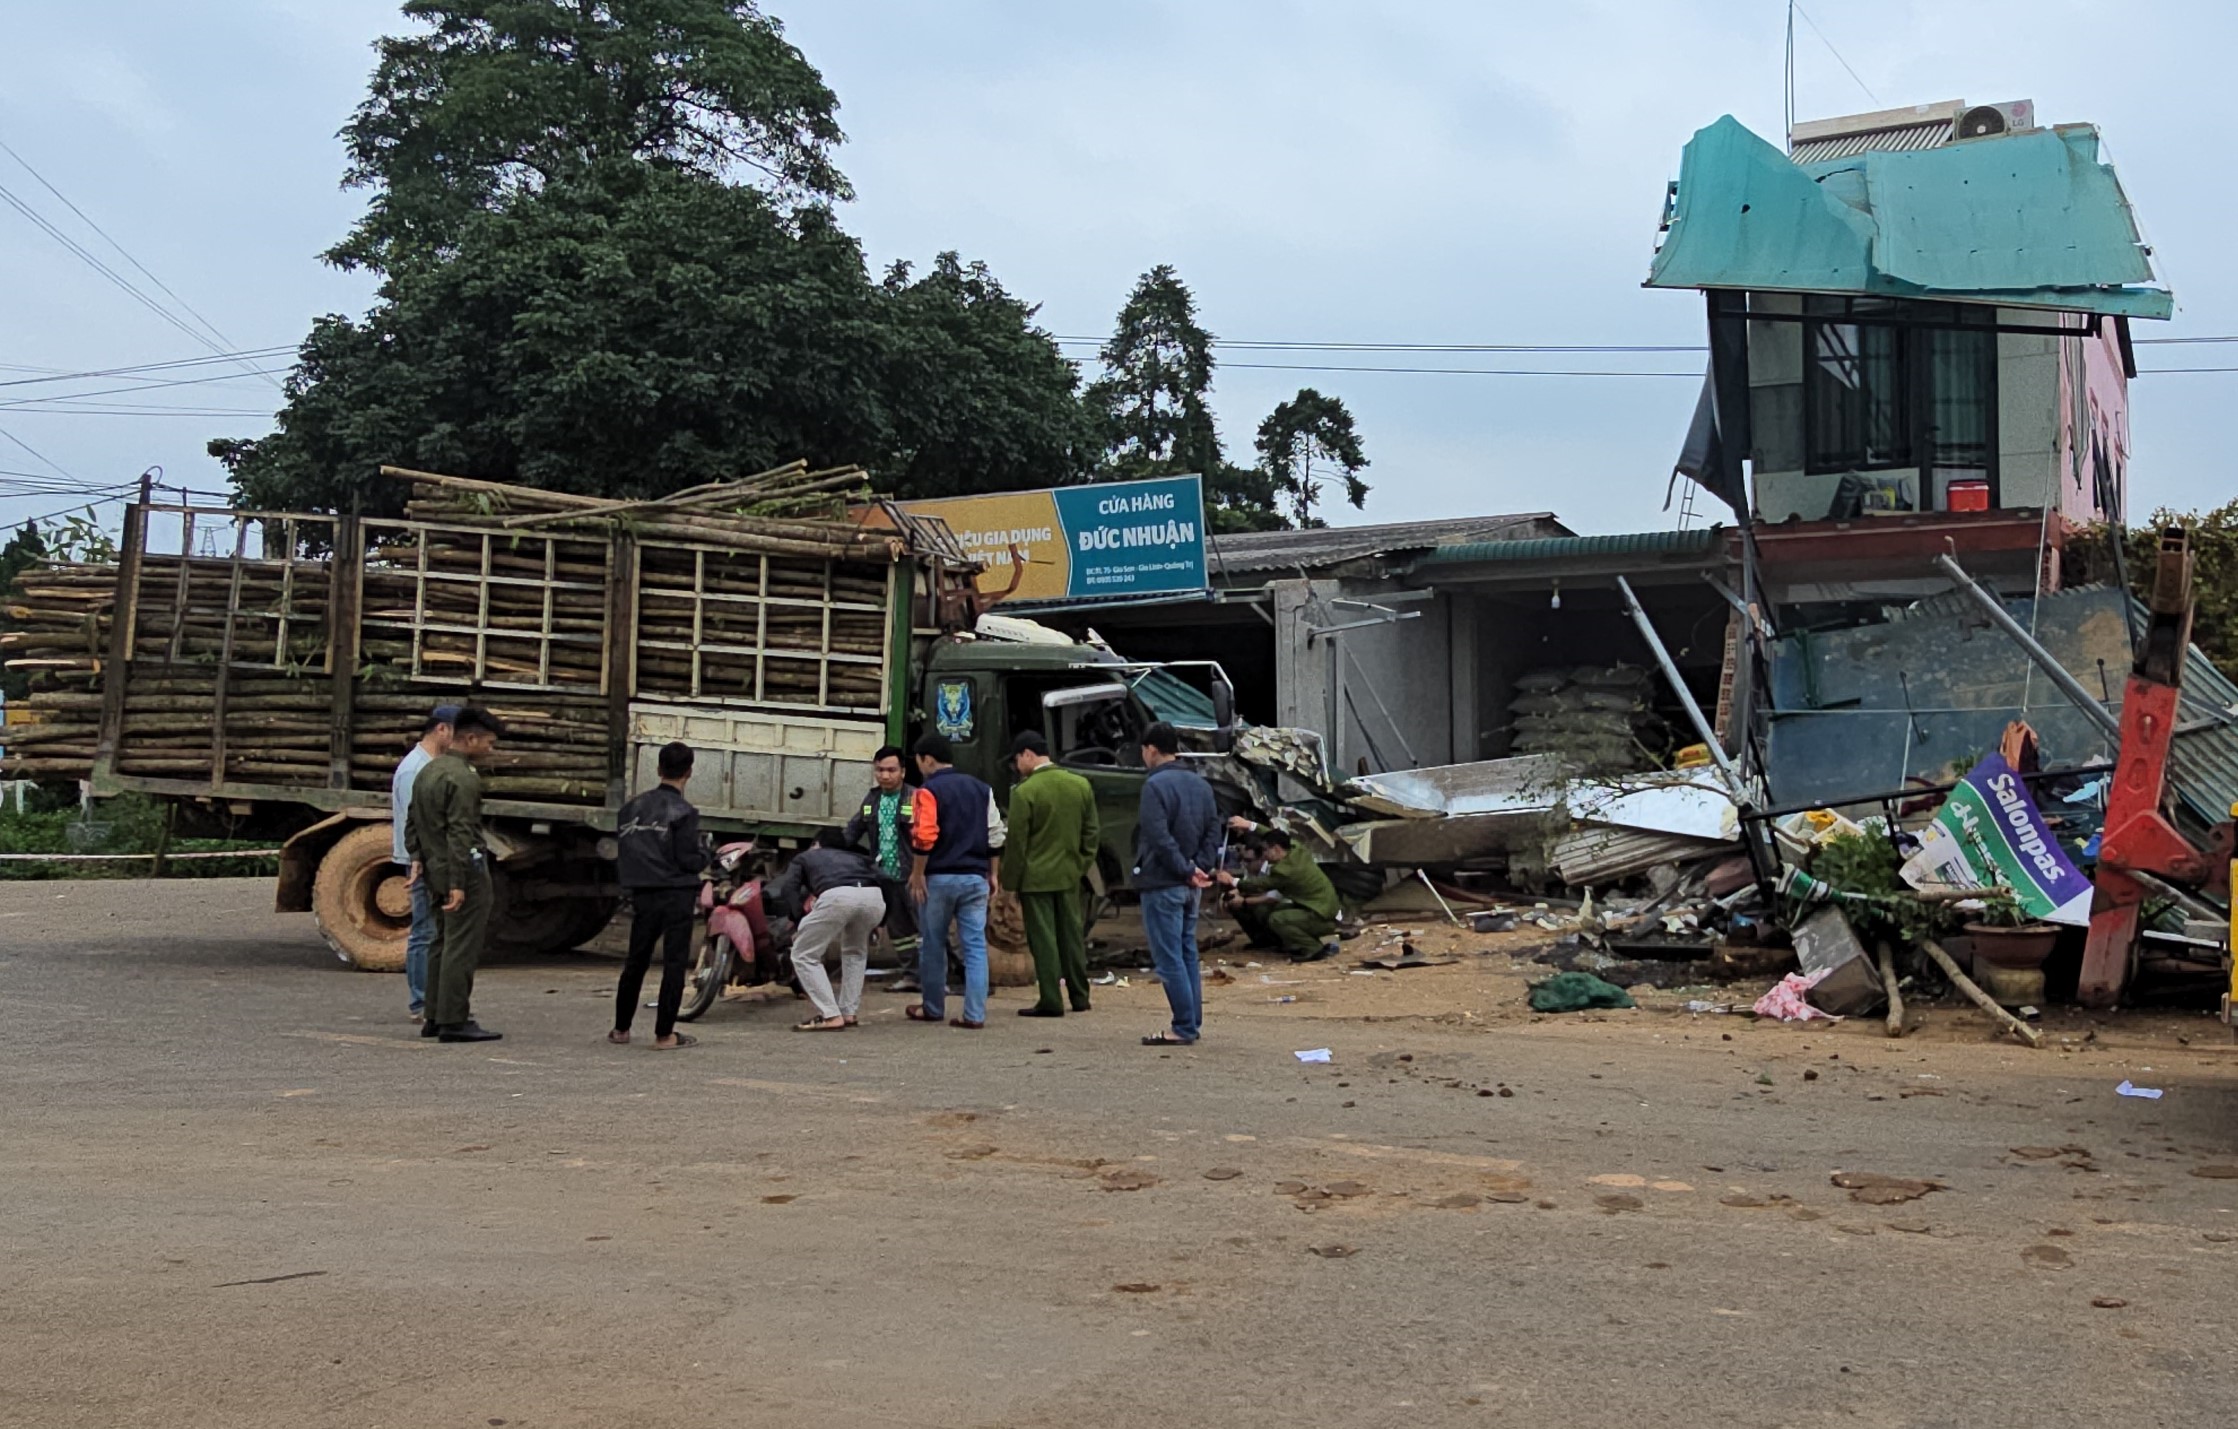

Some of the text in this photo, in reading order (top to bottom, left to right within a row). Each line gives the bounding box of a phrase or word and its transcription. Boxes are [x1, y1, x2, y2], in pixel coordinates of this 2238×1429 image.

[1098, 492, 1175, 515] CỬA HÀNG
[983, 530, 1009, 546] GIA
[1010, 527, 1052, 546] DỤNG
[1078, 519, 1195, 551] ĐỨC NHUẬN
[1986, 773, 2066, 882] Salonpas
